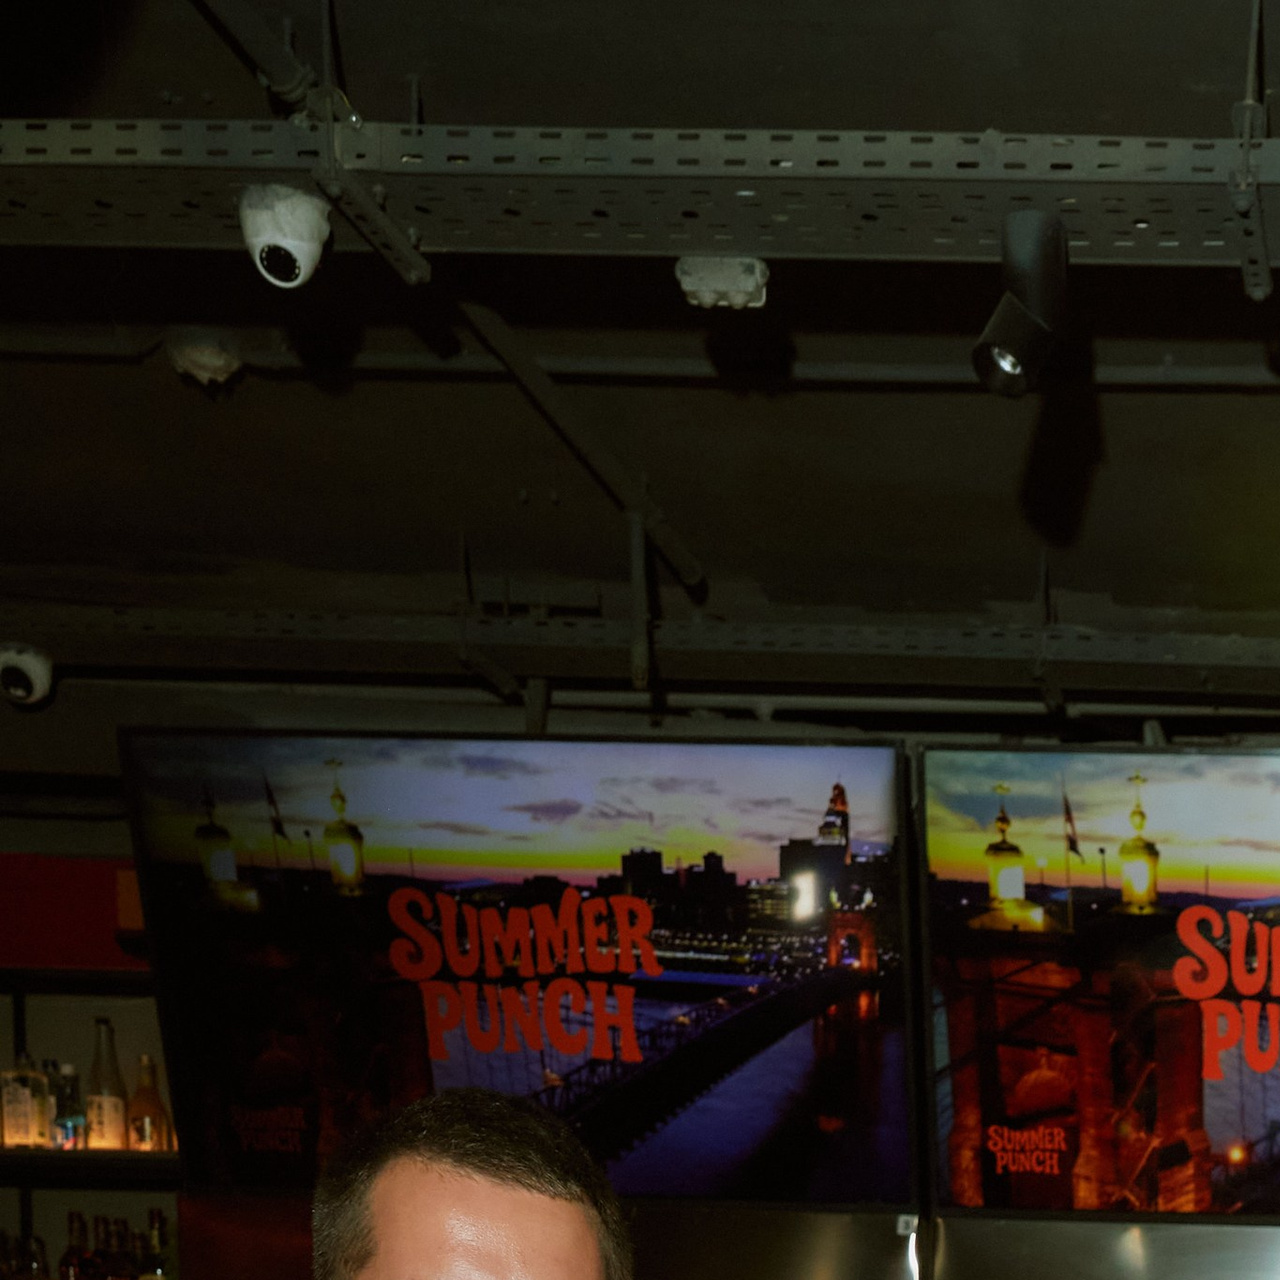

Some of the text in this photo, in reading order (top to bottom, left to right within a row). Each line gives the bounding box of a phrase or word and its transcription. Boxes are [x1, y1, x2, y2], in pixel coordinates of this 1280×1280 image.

[387, 887, 664, 980] SUMMER
[419, 977, 643, 1063] PUNCH
[987, 1124, 1067, 1153] SUMMER
[996, 1151, 1060, 1175] PUNCH
